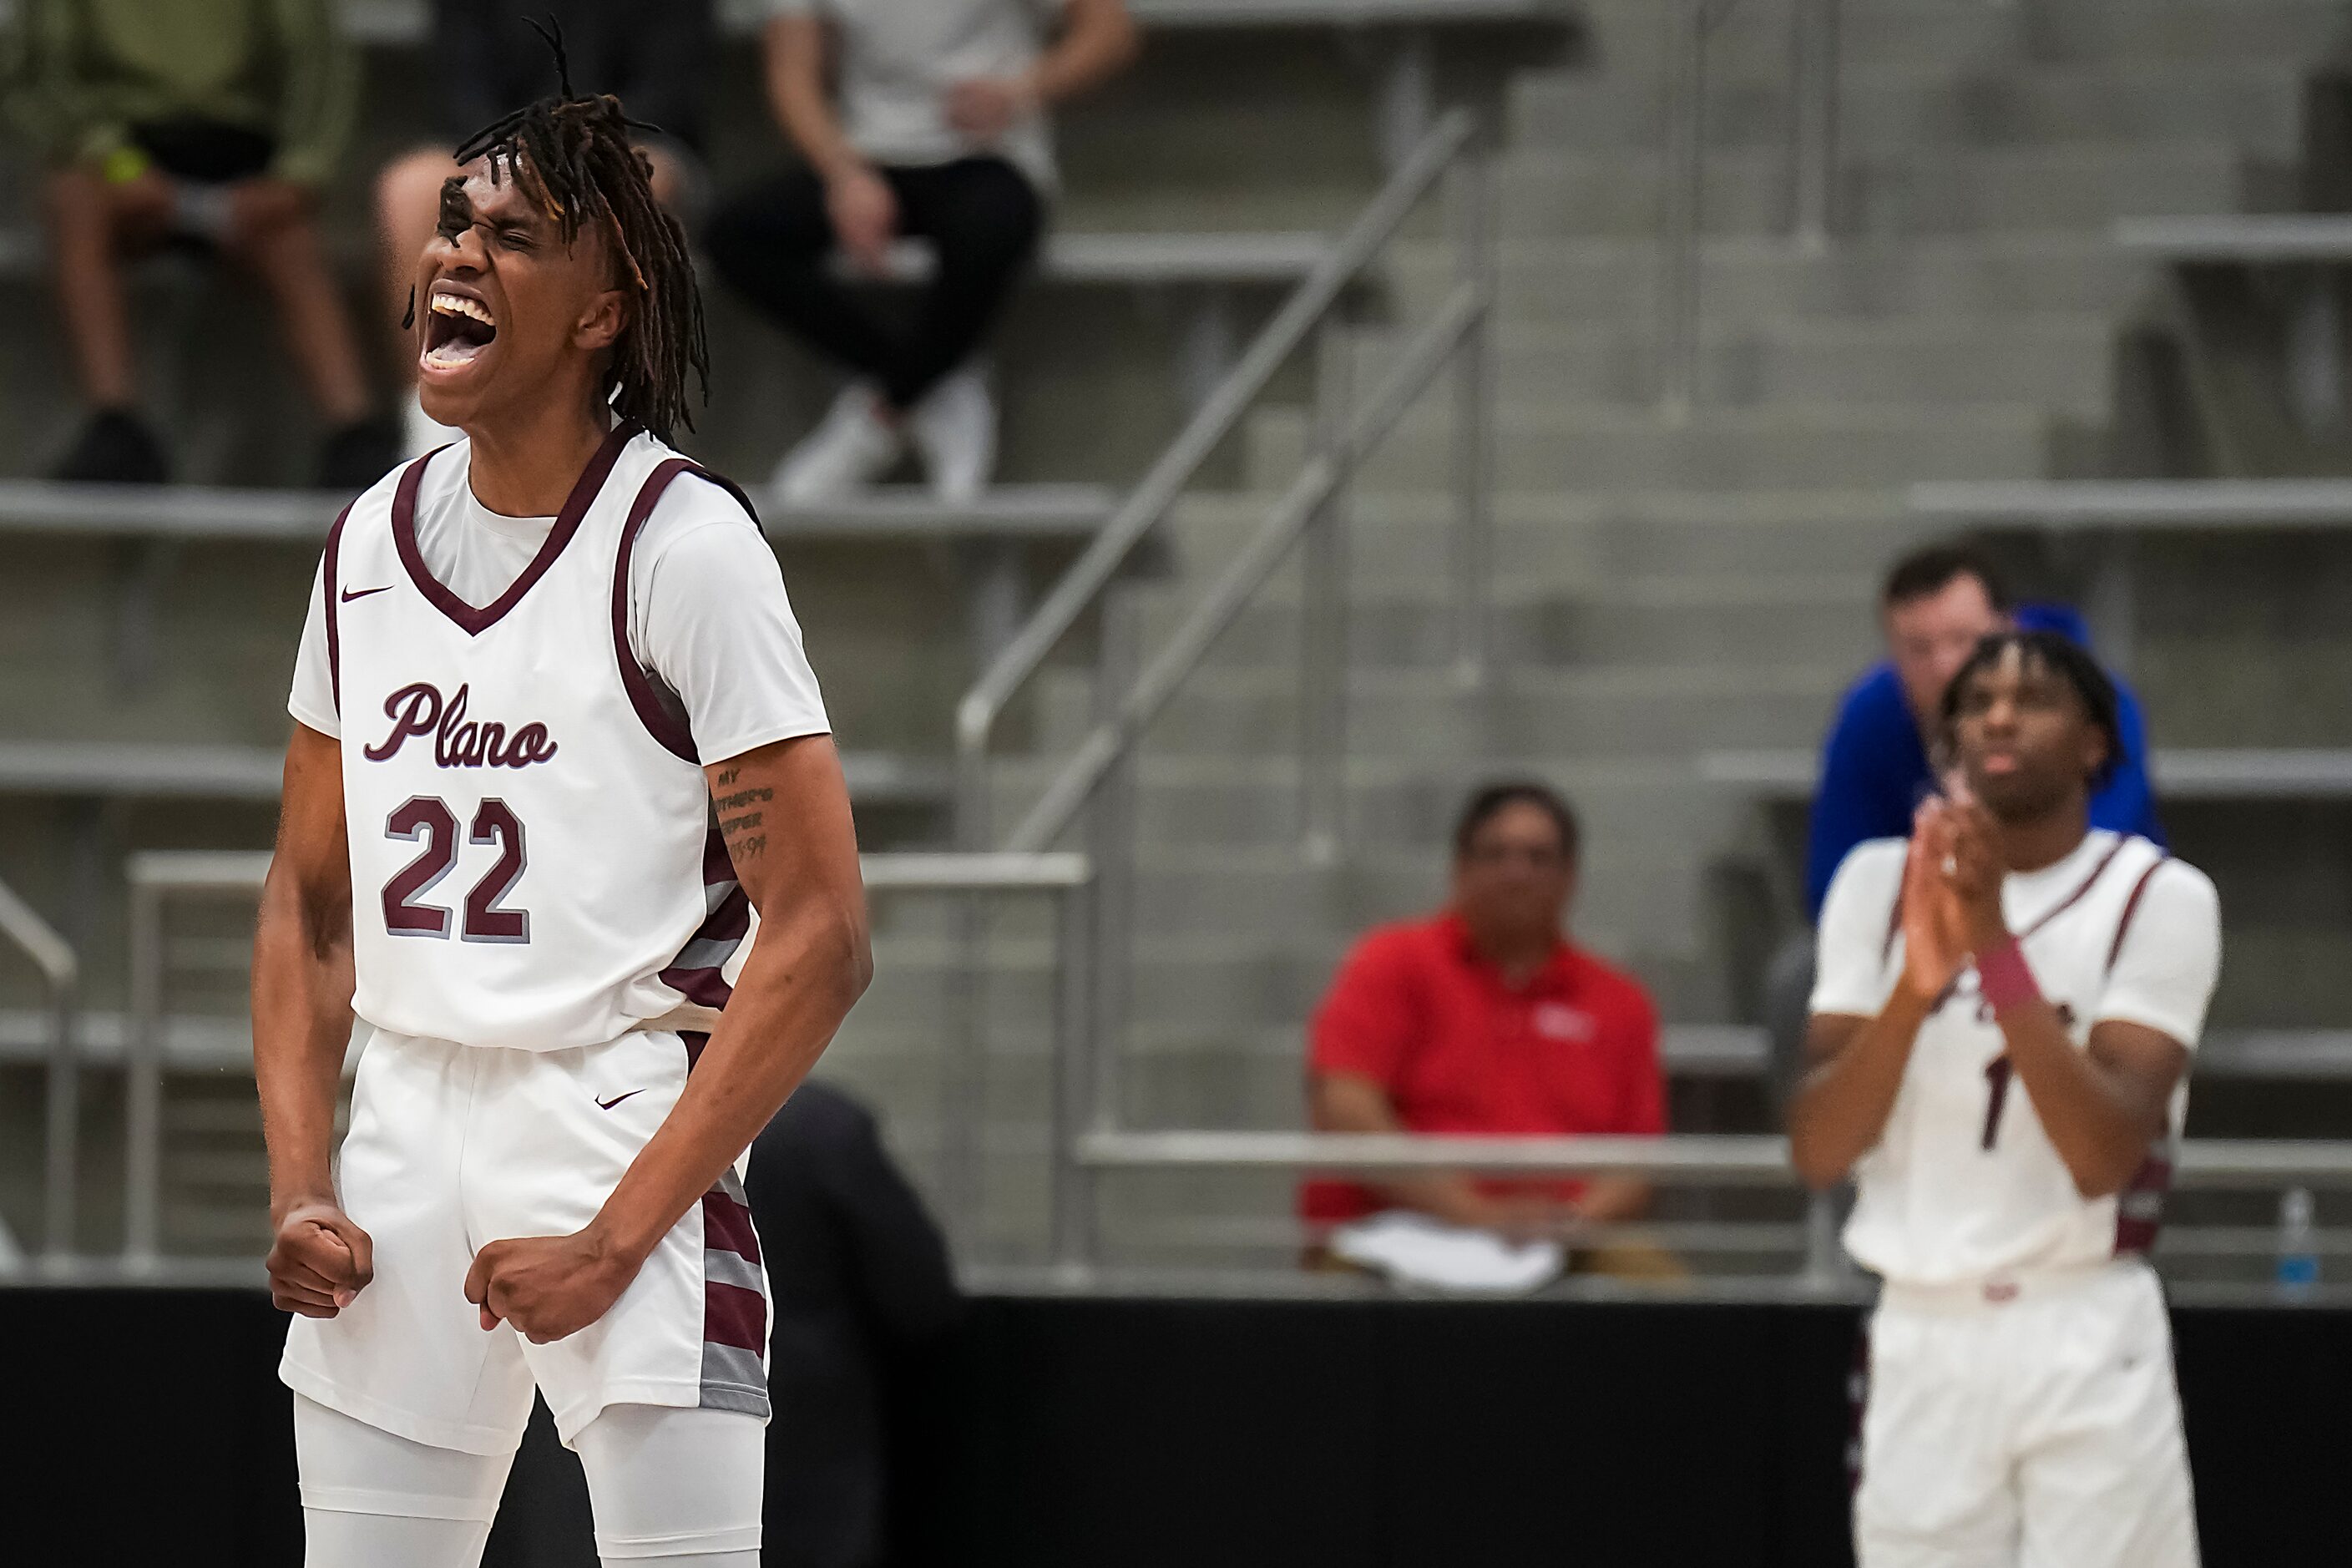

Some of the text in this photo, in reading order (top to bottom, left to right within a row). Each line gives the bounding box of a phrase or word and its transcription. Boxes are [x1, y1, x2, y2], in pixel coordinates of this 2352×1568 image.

[363, 682, 559, 769] Plano
[718, 768, 741, 787] MY
[381, 795, 530, 944] 22
[1983, 1055, 2013, 1151] 1
